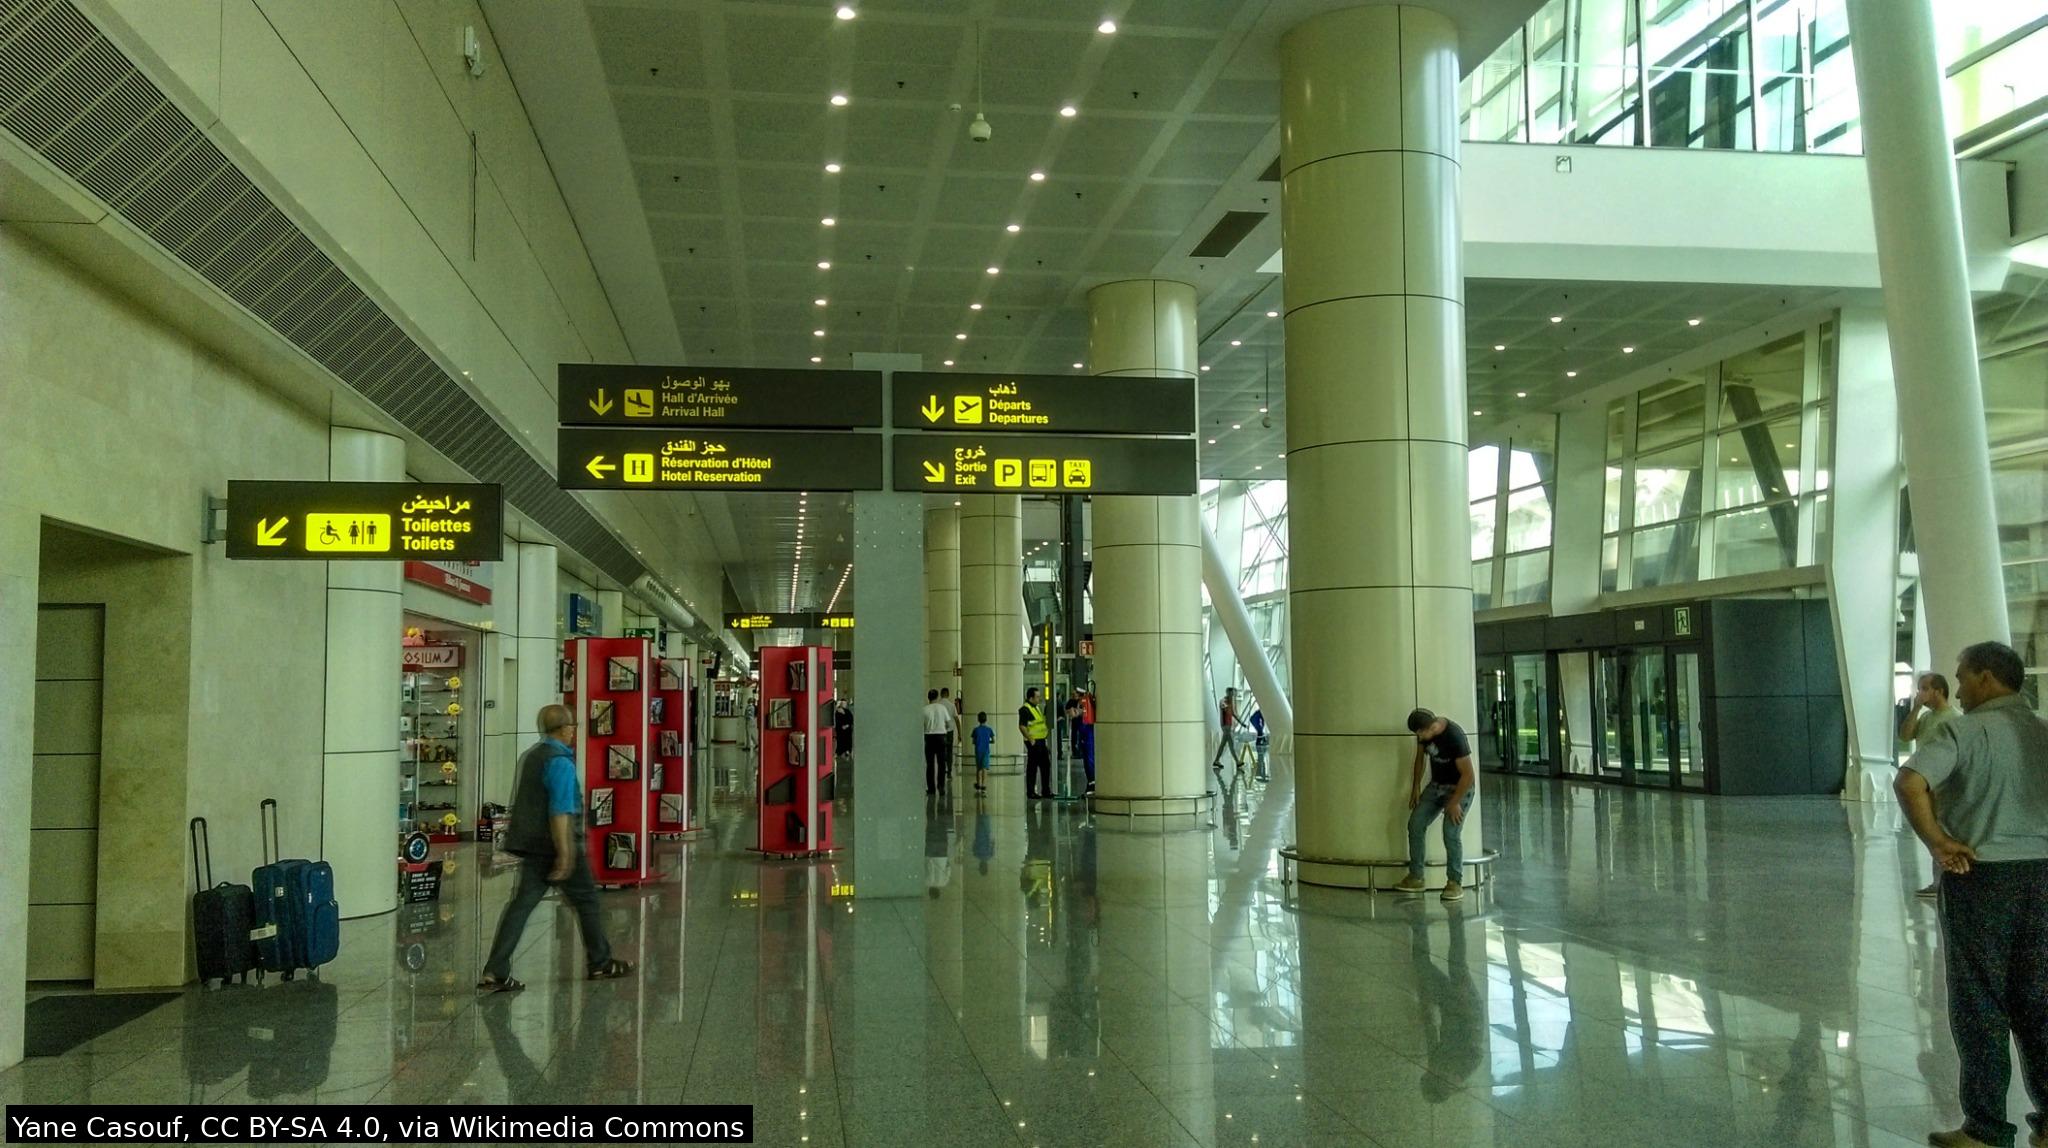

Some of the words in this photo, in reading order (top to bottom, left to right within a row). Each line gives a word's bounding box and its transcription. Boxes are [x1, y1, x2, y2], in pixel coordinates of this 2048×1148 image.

[661, 376, 705, 390] الوصول
[711, 378, 730, 392] بهو
[988, 381, 1017, 397] ذهاب
[662, 392, 684, 402] Hall
[688, 393, 738, 405] d'Arrivée
[989, 399, 1031, 411] Départs
[662, 406, 699, 417] Arrival
[703, 407, 725, 417] Hall
[989, 412, 1049, 425] Departures
[661, 440, 696, 456] الفندق
[700, 442, 726, 456] حجز
[954, 445, 986, 461] خروج
[661, 456, 729, 469] Réservation
[732, 457, 772, 469] d'Hôtel
[955, 461, 987, 472] Sortie
[661, 471, 691, 482] Hotel
[694, 471, 761, 483] Reservation
[955, 474, 976, 485] Exit
[1002, 464, 1016, 482] P
[401, 495, 470, 514] مراحيض
[401, 517, 471, 533] Toilettes
[401, 536, 455, 551] Toilets
